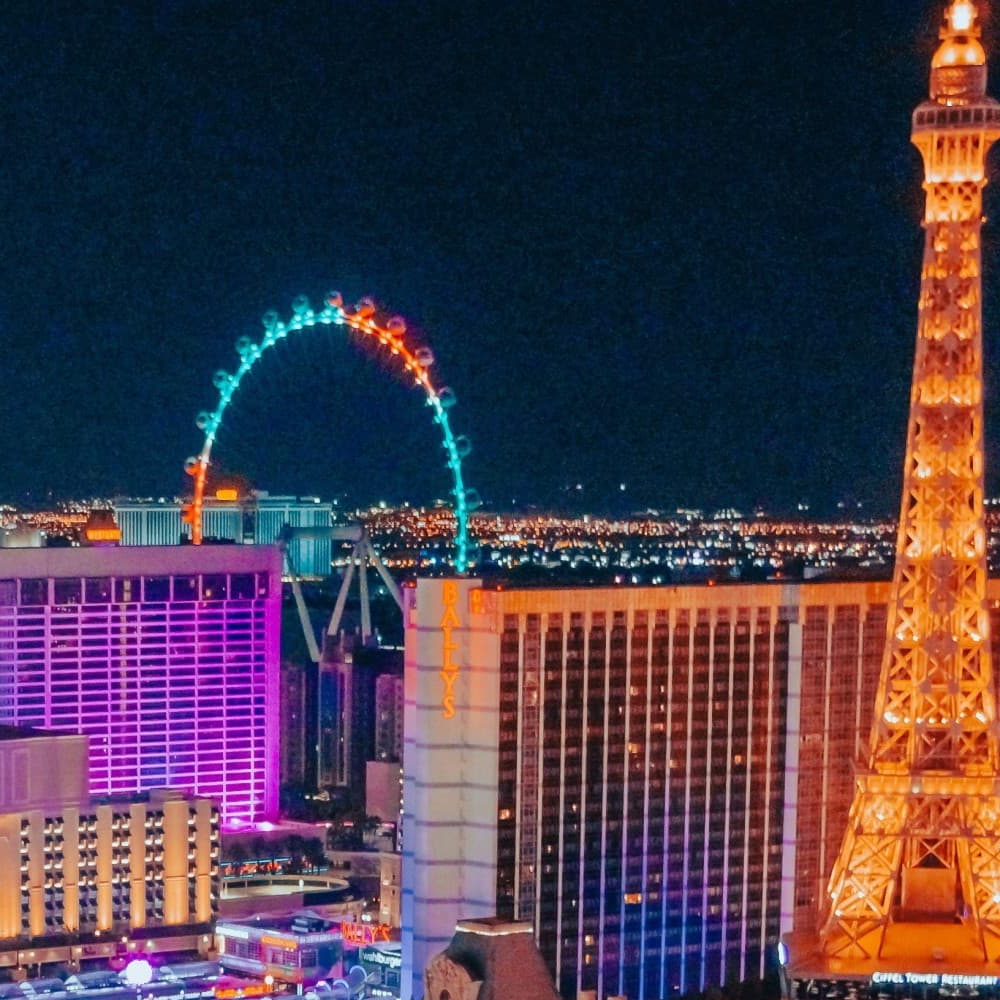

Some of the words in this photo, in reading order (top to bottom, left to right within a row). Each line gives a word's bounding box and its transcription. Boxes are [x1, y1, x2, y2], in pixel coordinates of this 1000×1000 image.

[872, 971, 904, 984] EIFFEL
[905, 972, 938, 984] TOWER
[941, 973, 998, 985] RESTAURANT
